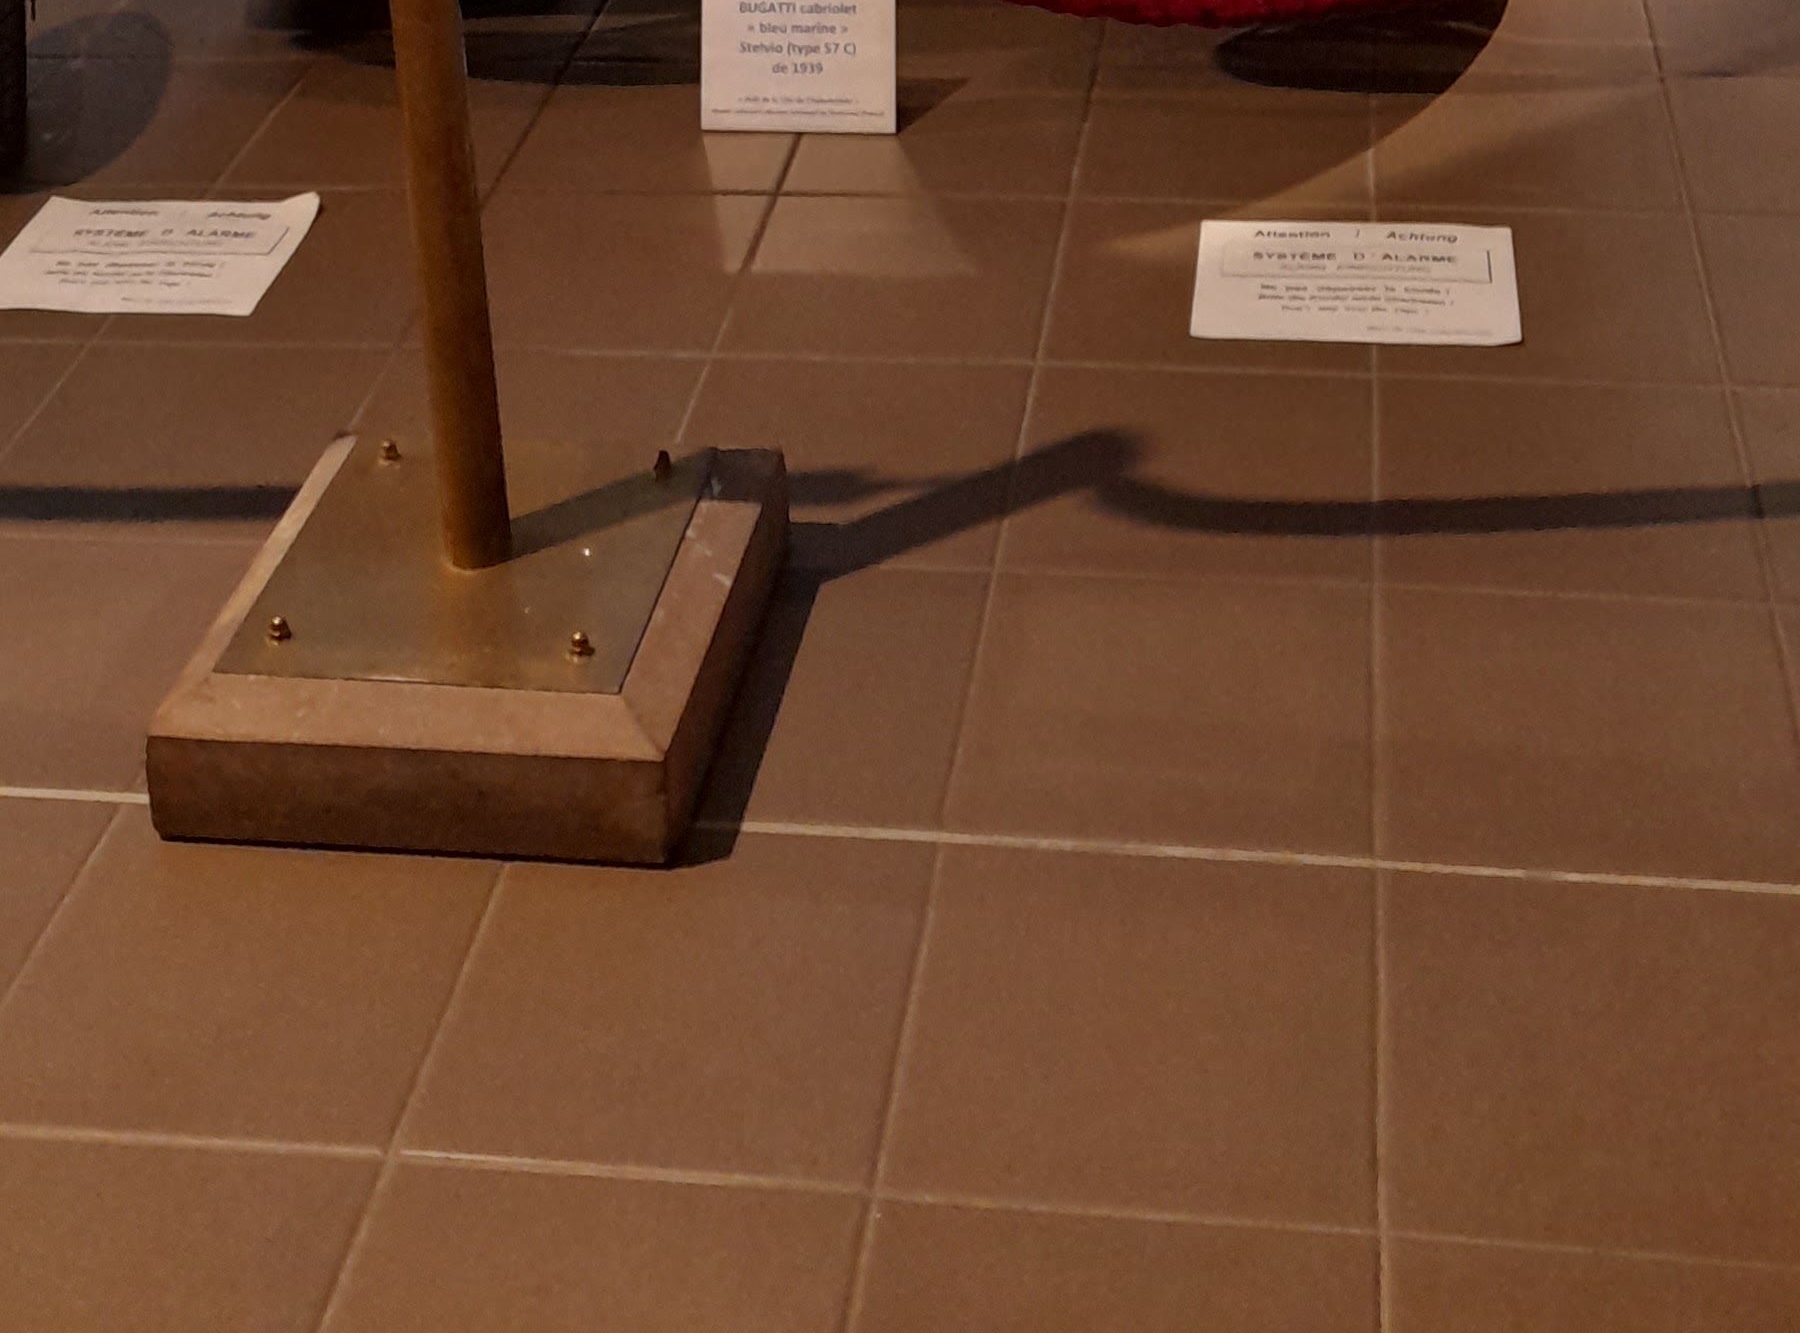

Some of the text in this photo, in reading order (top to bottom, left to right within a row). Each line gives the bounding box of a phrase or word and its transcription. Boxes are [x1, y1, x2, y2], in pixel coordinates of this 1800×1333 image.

[739, 1, 857, 15] BUGATTI cabriolet
[759, 22, 788, 34] bleu
[791, 23, 837, 34] marine
[739, 41, 784, 54] Stelvio
[772, 62, 824, 75] de 1939
[1386, 230, 1459, 244] Achtung
